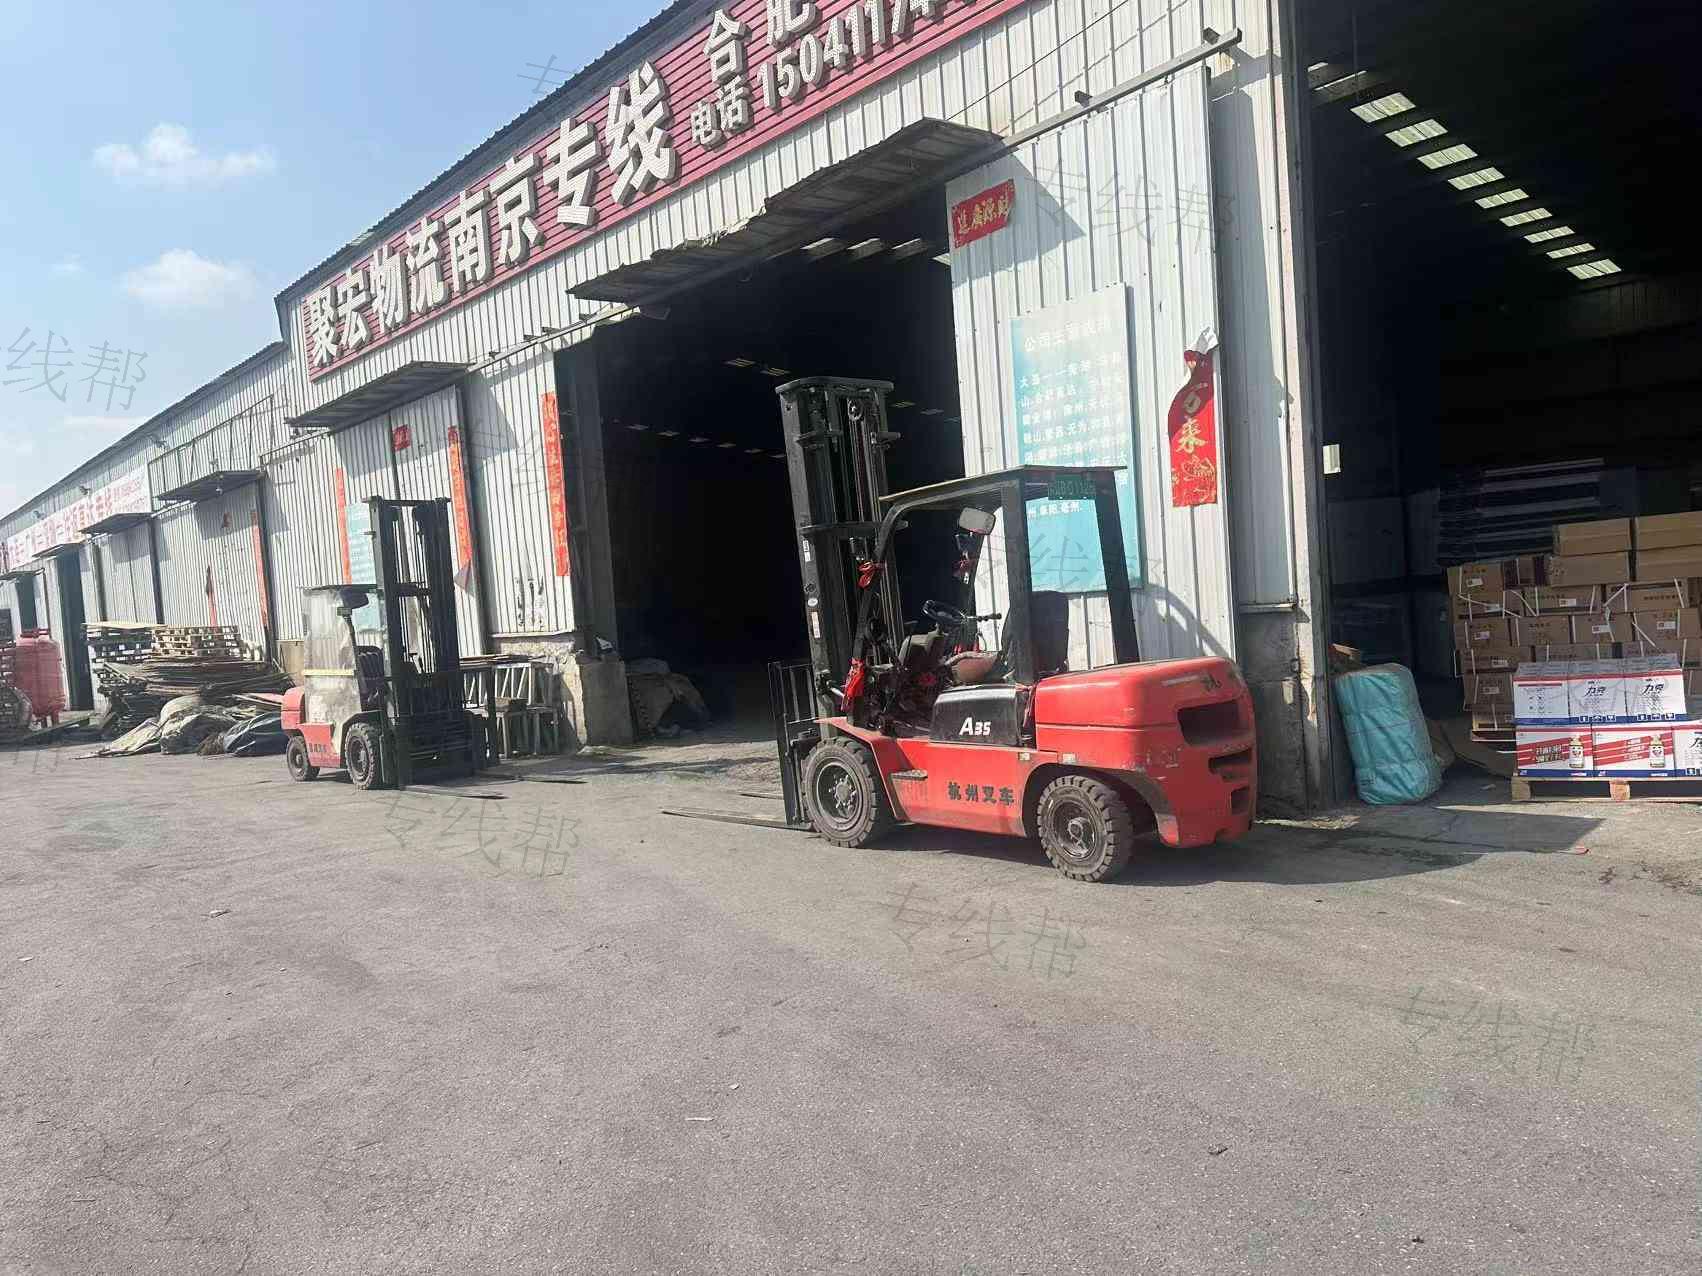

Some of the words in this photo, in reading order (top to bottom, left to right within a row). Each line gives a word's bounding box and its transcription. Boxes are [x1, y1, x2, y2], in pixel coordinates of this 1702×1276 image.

[690, 76, 750, 147] 电话
[959, 717, 991, 737] A35
[947, 780, 1015, 807] 杭州叉车
